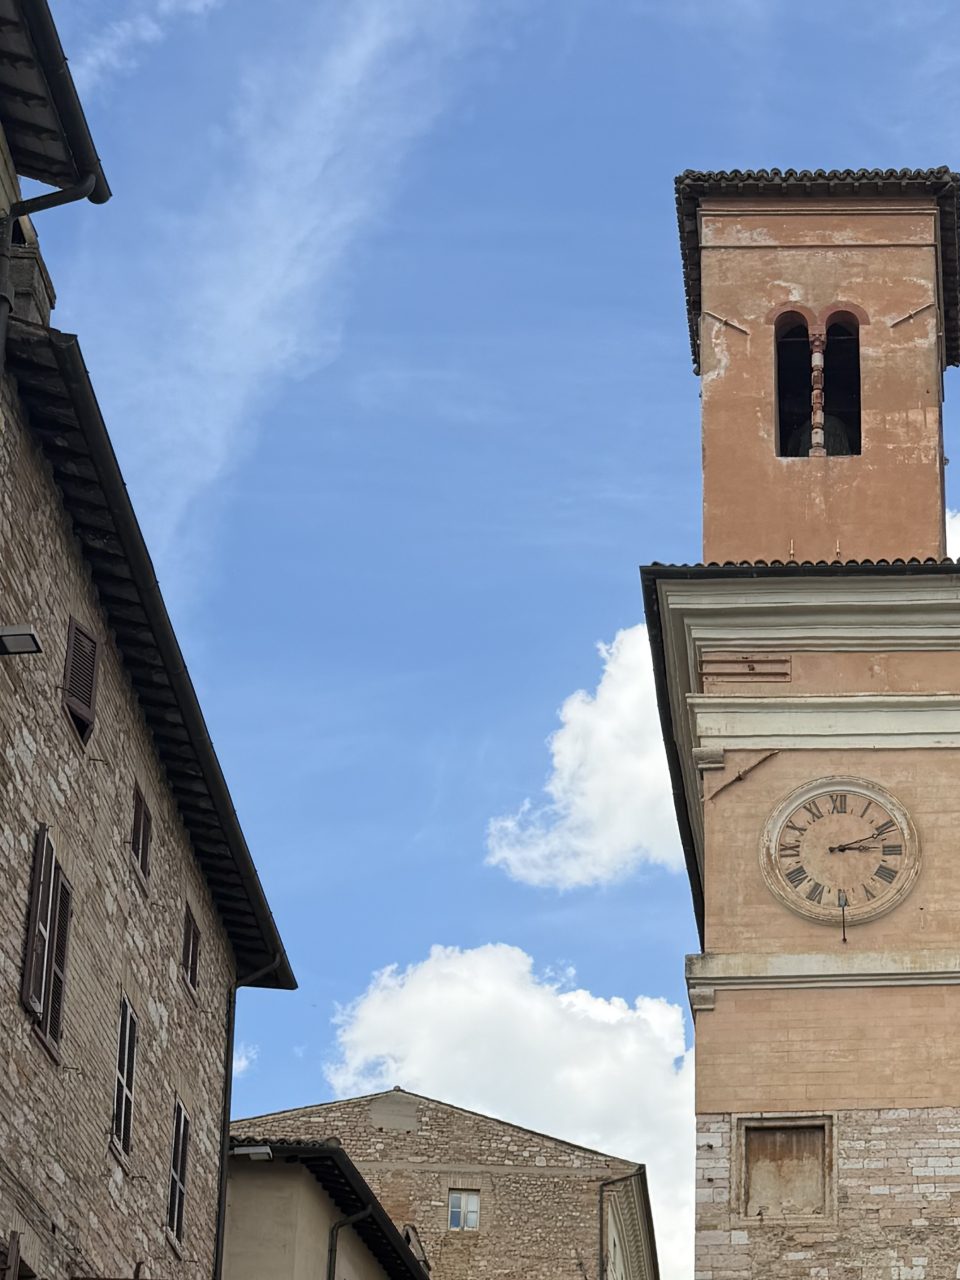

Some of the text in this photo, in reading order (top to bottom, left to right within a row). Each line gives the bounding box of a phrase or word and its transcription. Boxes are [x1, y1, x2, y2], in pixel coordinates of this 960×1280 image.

[803, 800, 824, 822] XI
[830, 795, 847, 814] XII
[786, 820, 807, 836] X
[780, 843, 800, 858] IX
[882, 845, 902, 855] III
